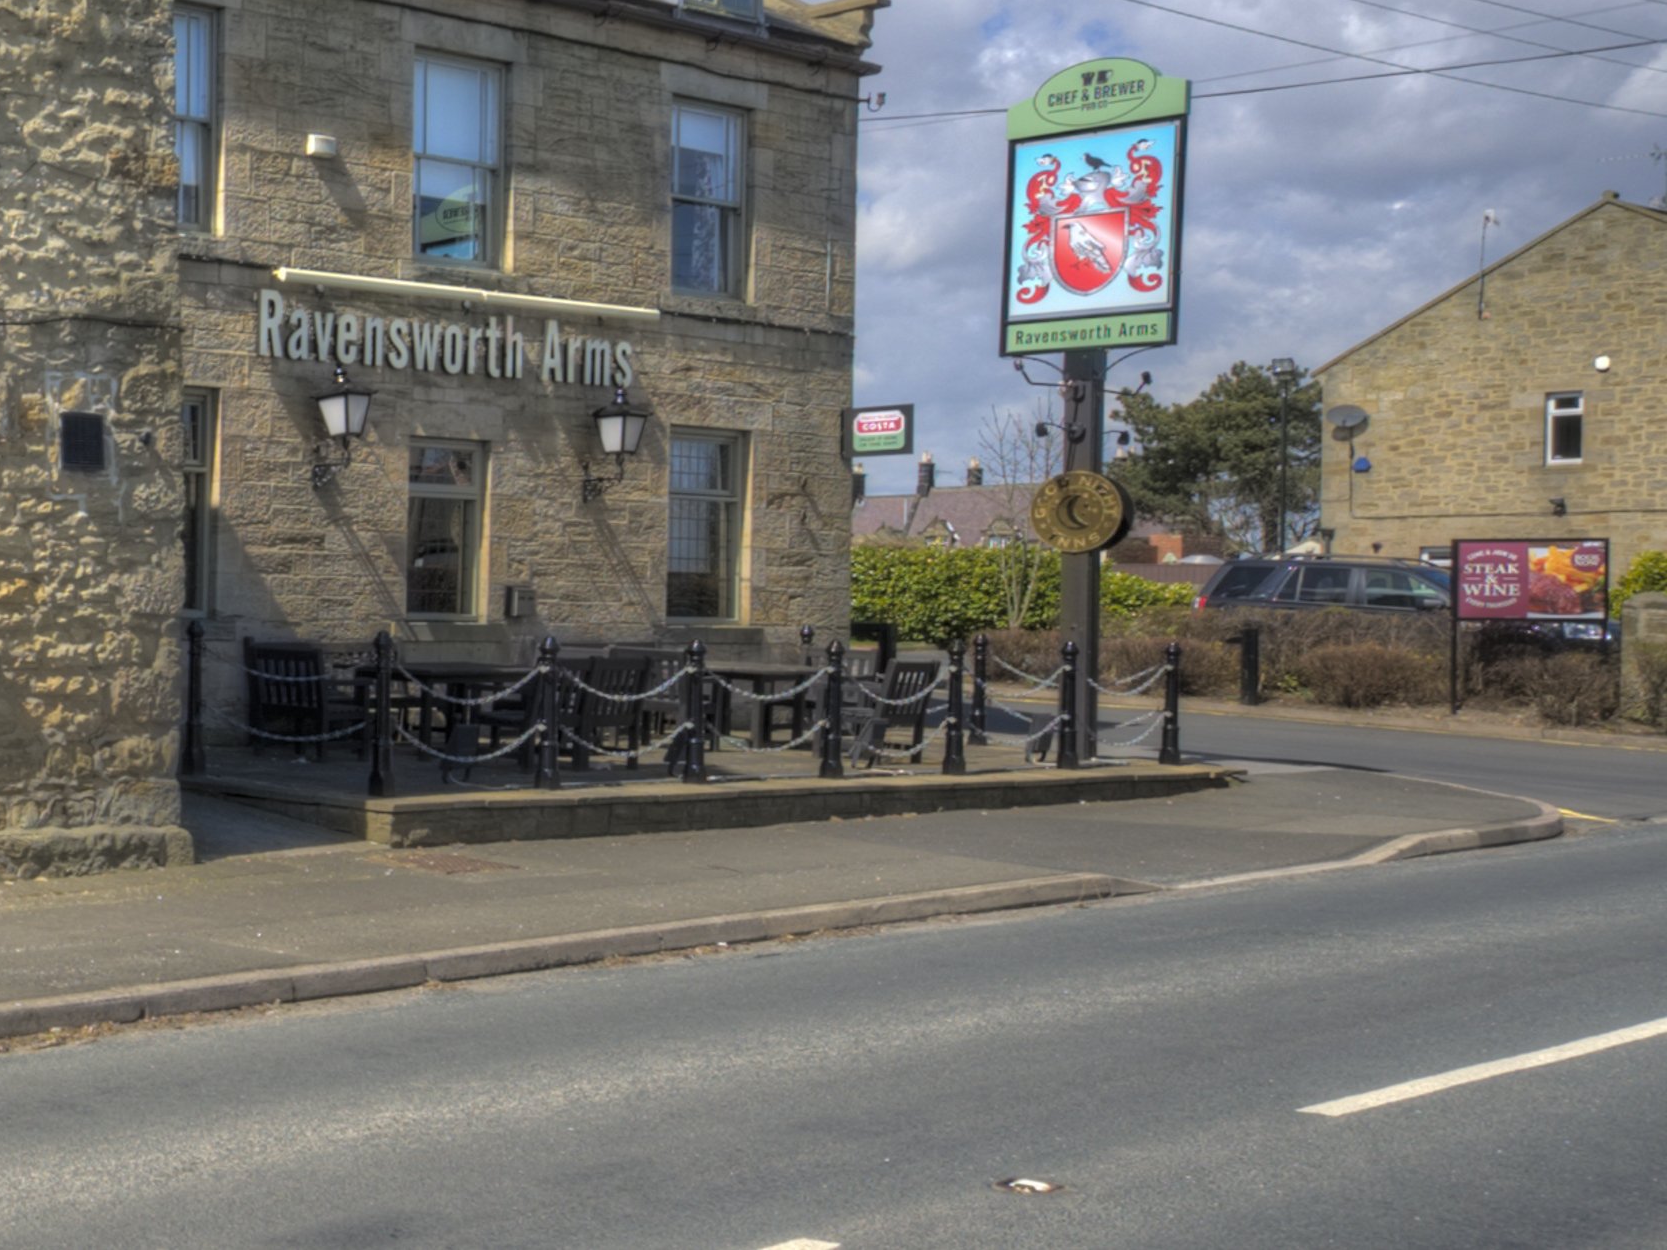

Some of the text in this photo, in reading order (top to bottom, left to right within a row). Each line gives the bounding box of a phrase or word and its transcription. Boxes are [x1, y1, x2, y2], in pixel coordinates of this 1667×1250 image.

[1048, 79, 1145, 107] CHEF & BREWER
[258, 288, 633, 388] Ravensworth Arms
[1015, 322, 1158, 345] Ravensworth Arms
[862, 421, 896, 431] COSTA
[1463, 563, 1519, 574] STEAK
[1485, 574, 1498, 584] &
[1463, 583, 1520, 596] WINE
